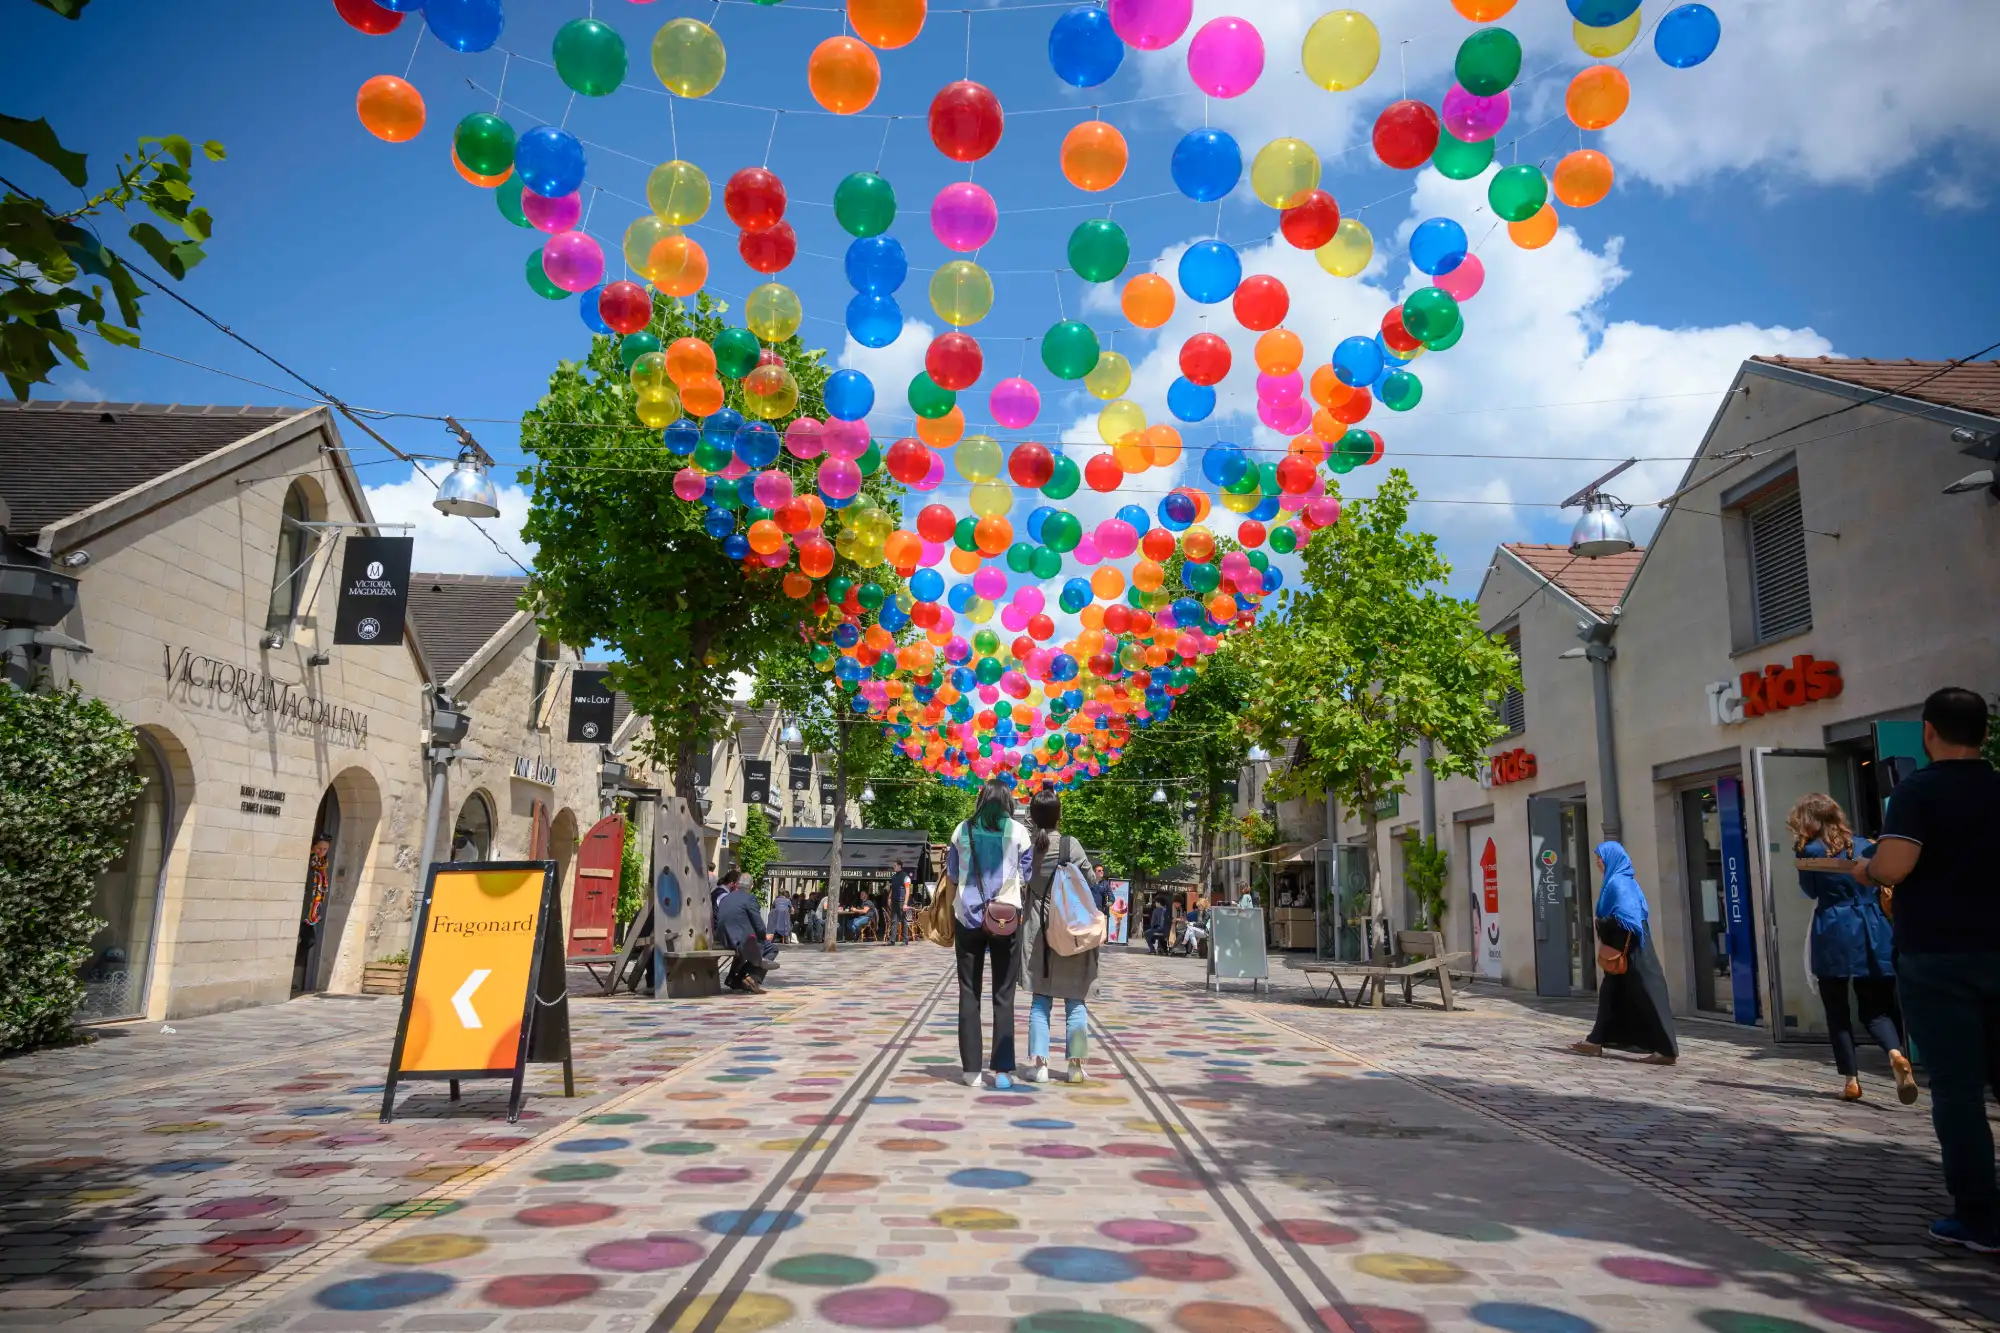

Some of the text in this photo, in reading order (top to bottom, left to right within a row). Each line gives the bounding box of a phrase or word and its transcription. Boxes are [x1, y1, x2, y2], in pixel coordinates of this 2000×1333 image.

[348, 587, 397, 596] MAGDALENA
[355, 580, 392, 590] VICTORIA
[164, 644, 368, 737] VICTORIA MAGDALENA
[432, 914, 534, 938] Fragonard
